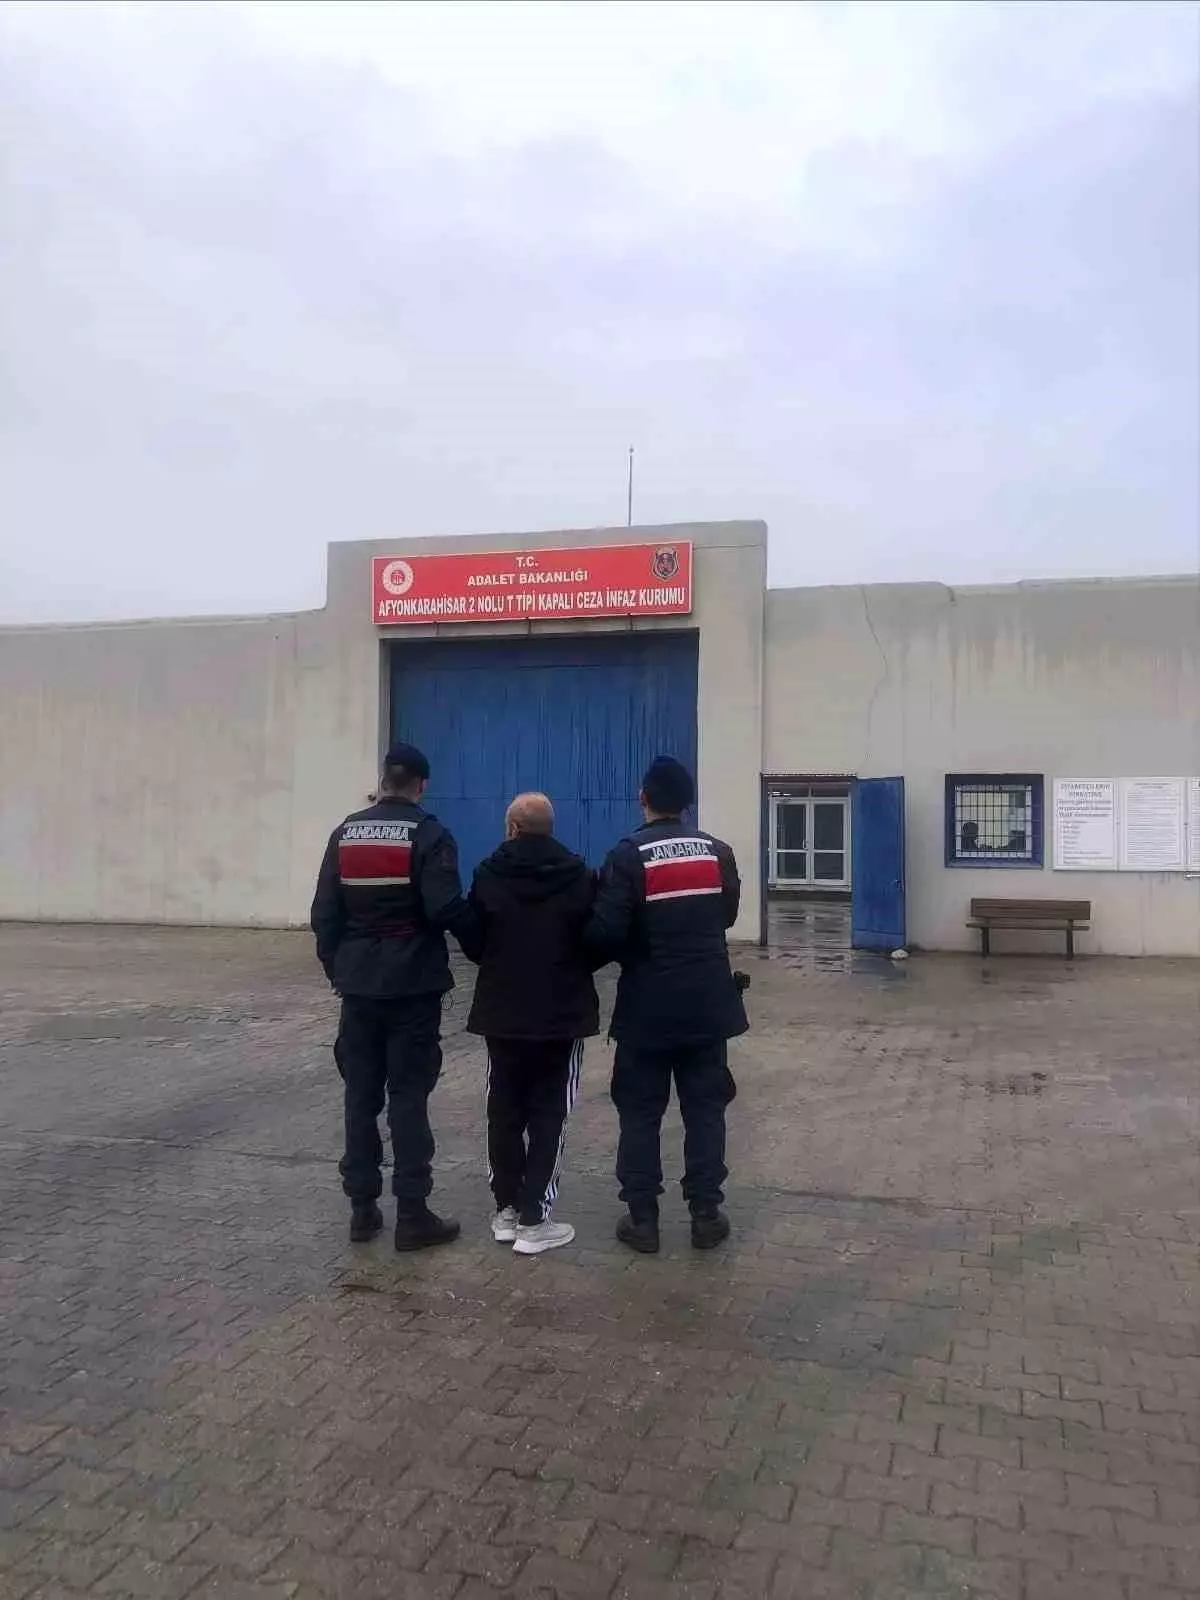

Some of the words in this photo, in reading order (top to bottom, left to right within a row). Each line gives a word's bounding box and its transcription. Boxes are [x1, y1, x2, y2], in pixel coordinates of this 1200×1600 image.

[516, 556, 539, 568] T.C.
[467, 574, 515, 586] ADALET
[519, 569, 588, 584] BAKANLIĞI
[378, 594, 466, 617] AFYONKARAHİSAR
[466, 598, 475, 613] 2
[477, 595, 504, 613] NOLU
[515, 590, 536, 612] TİPİ
[538, 592, 574, 611] KAPALI
[576, 590, 604, 609] CEZA
[606, 587, 636, 608] İNFAZ
[639, 587, 685, 605] KURUMU
[342, 825, 409, 840] JANDARMA
[650, 843, 711, 861] JANDARMA
